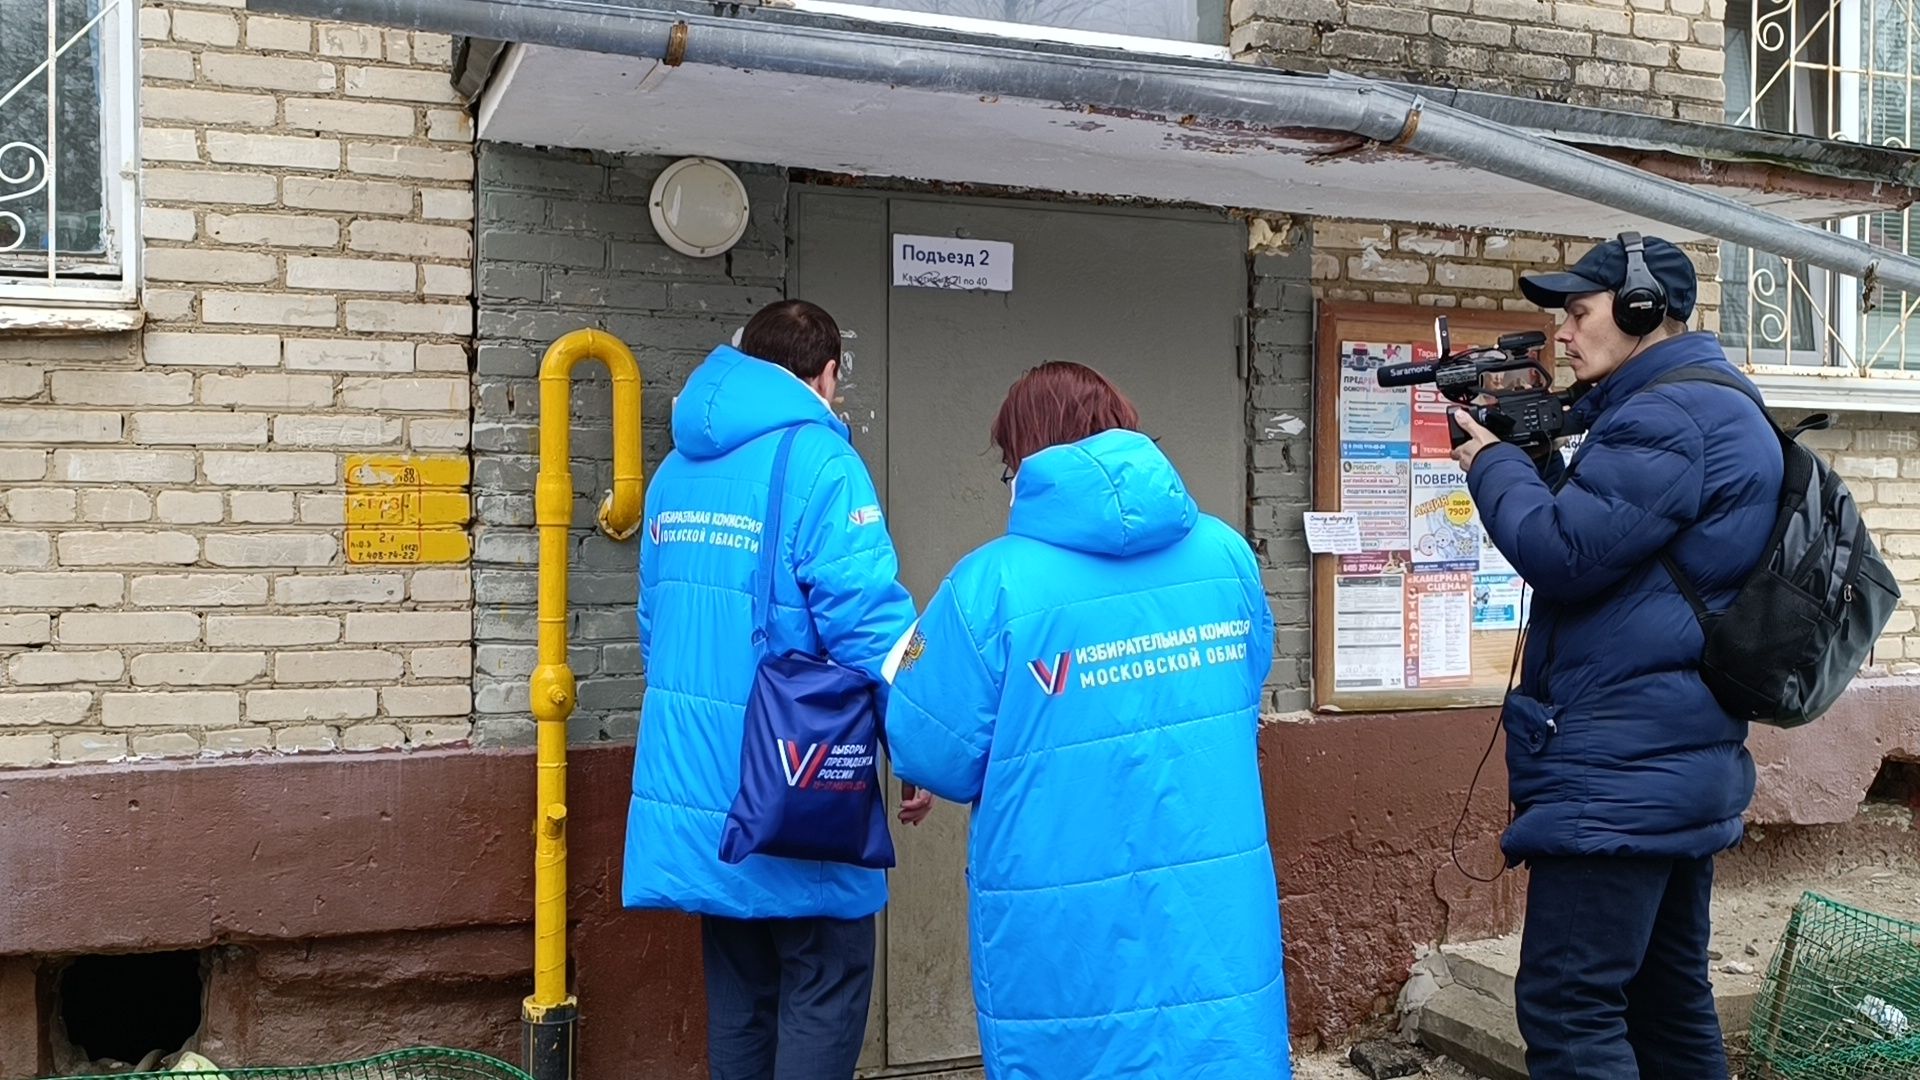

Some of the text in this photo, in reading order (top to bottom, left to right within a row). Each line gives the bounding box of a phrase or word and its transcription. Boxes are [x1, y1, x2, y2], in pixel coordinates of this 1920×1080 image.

[902, 244, 990, 267] Подъезд 2
[964, 278, 975, 286] по
[976, 277, 988, 286] 40
[1390, 364, 1432, 377] Saramonic
[1414, 495, 1450, 518] АКЦИЯ
[712, 512, 764, 535] КОМИССИЯ
[709, 531, 760, 554] ОБЛАСТИ
[1427, 582, 1468, 592] СЦЕНА»
[1075, 627, 1198, 665] ИЗБИРАТЕЛЬНАЯ
[1079, 647, 1202, 689] МОСКОВСКОЙ
[831, 745, 867, 755] ВЫБОРЫ
[824, 756, 874, 768] ПРЕЗИДЕНТА
[817, 769, 855, 780] РОССИИ
